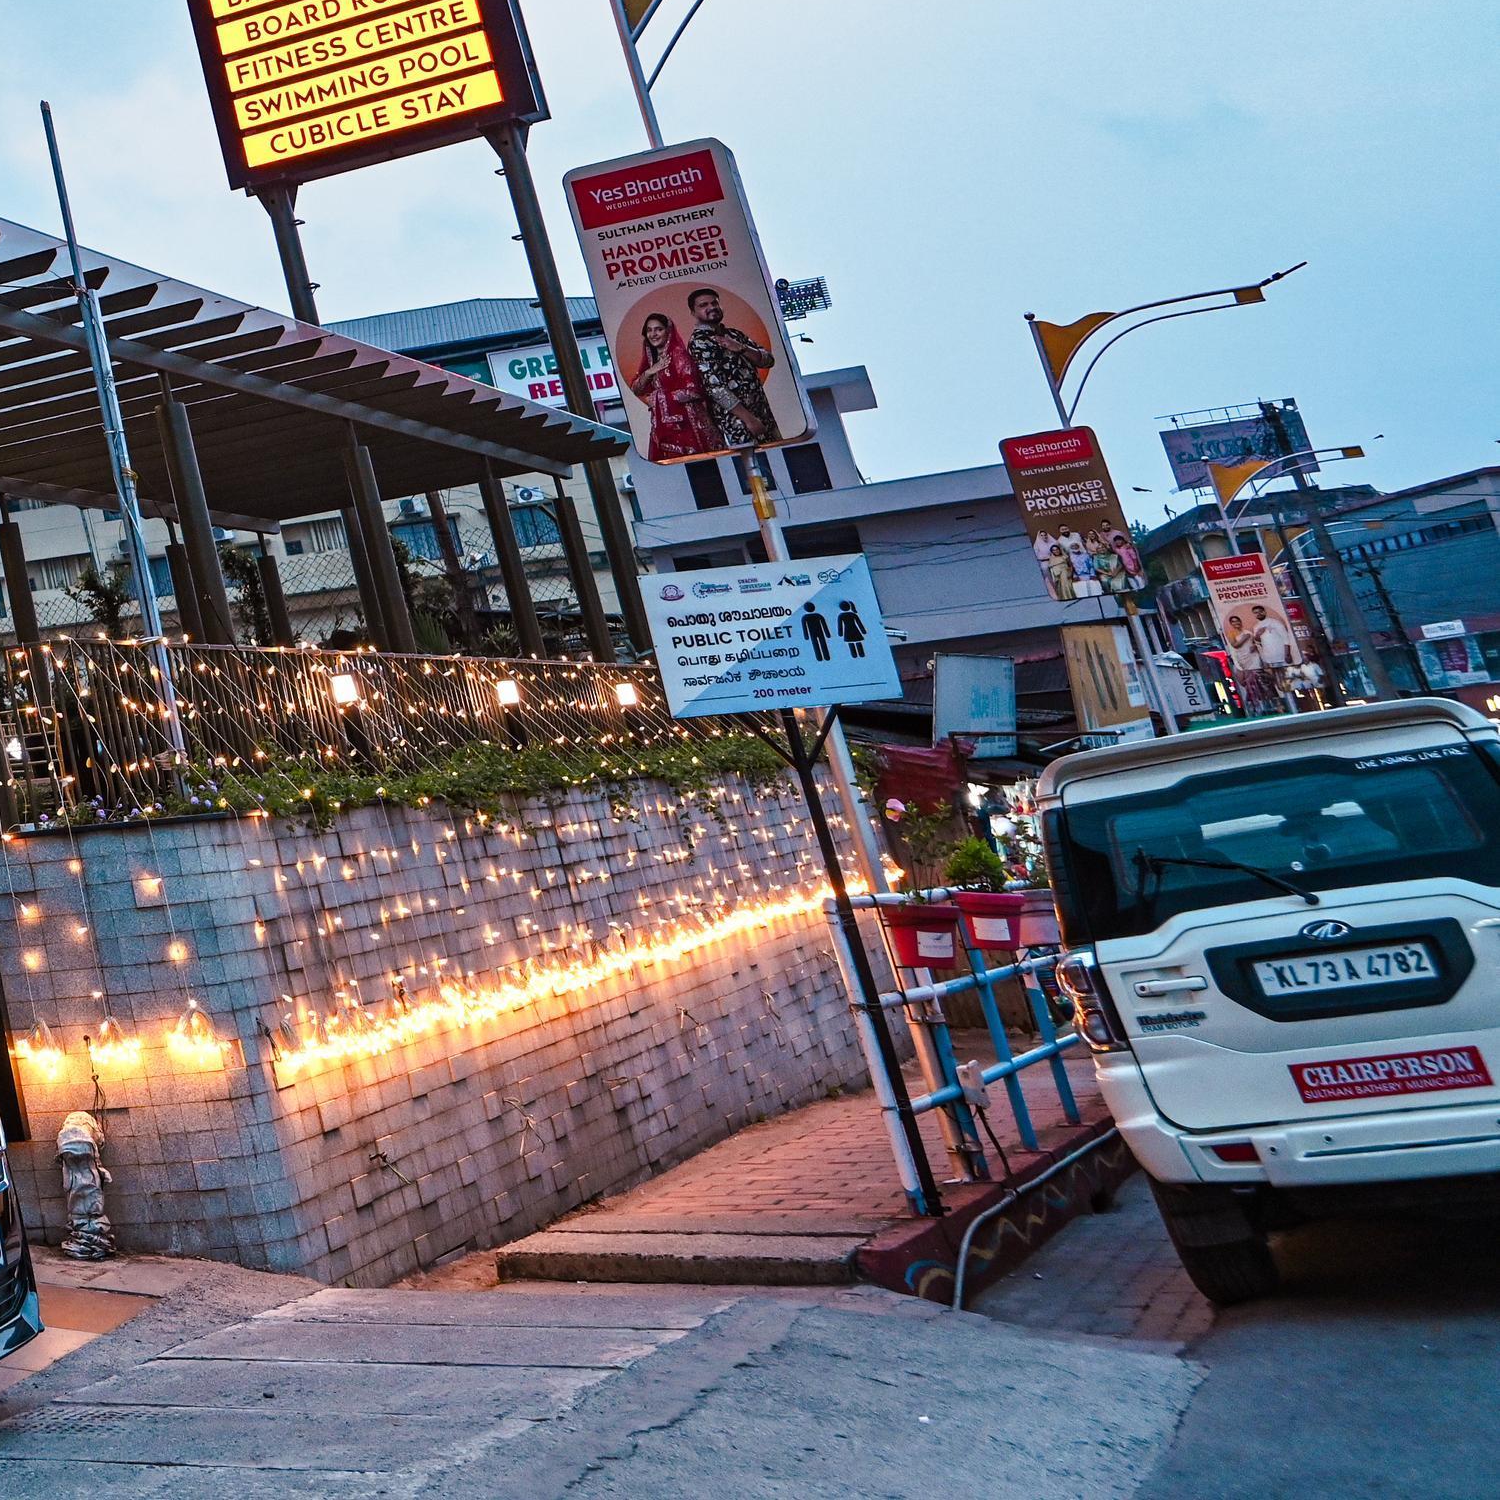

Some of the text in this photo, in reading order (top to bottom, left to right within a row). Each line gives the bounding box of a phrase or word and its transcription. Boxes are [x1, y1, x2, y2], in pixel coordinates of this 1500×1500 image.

[236, 1, 468, 84] FITNESS CENTRE
[244, 41, 479, 121] SWIMMING POOL
[269, 84, 468, 154] CUBICLE STAY
[590, 167, 702, 204] Yes Bharath
[605, 187, 694, 211] WEDDING COLLECTIONS
[597, 207, 715, 241] SULTHAN BATHERY
[601, 225, 722, 261] HANDPICKED
[606, 238, 729, 280] PROMISE!
[627, 275, 657, 288] EVERY
[1015, 438, 1081, 456] Yes Bharath
[1020, 460, 1090, 476] SULTHAN BATHERY
[1021, 479, 1103, 499] HANDPICKED
[1025, 488, 1108, 512] PROMISE!
[1218, 588, 1268, 601] PROMISE!
[671, 625, 793, 649] PUBLIC TOILET
[752, 686, 812, 699] 200 meter
[1344, 958, 1362, 980] A
[1367, 950, 1429, 977] 4782
[1302, 1051, 1475, 1087] CHAIRPERSON
[1304, 1073, 1485, 1099] SULTHAN BATHERY MUNICIPALITY
